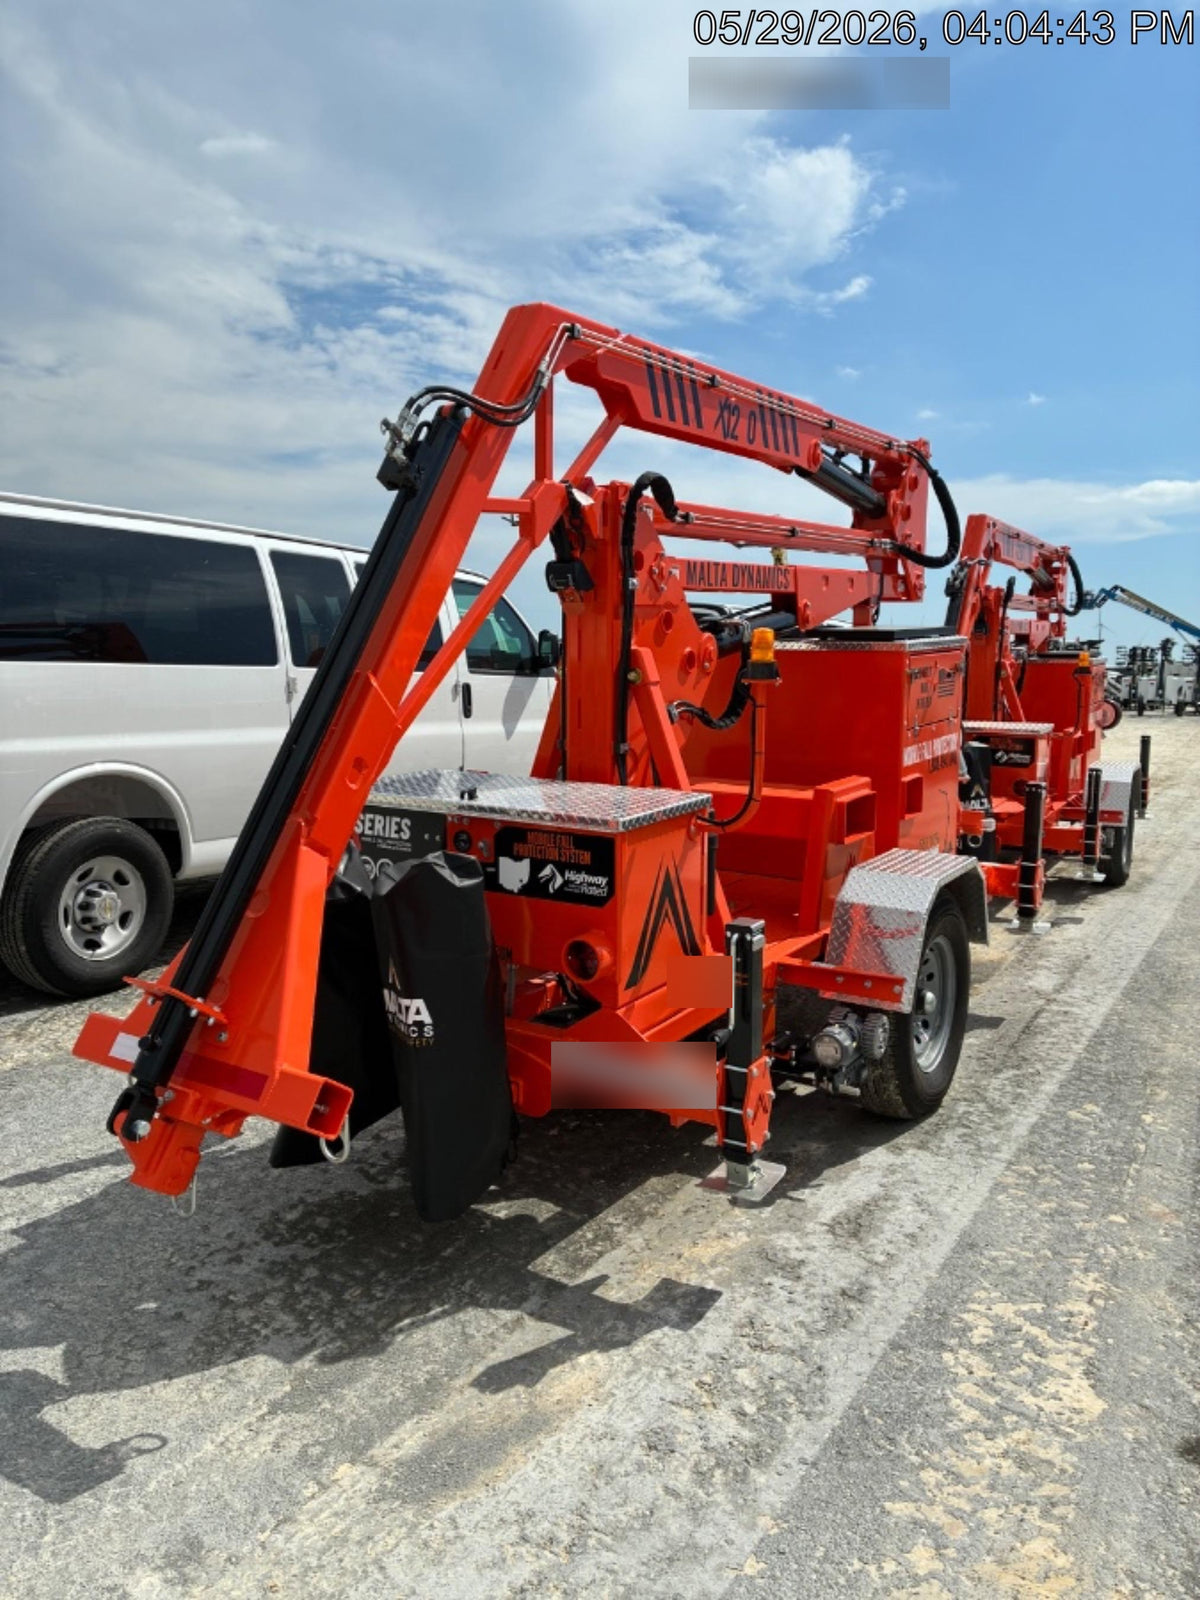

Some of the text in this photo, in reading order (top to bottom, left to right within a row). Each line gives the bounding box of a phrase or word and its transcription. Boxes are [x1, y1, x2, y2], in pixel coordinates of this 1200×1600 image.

[686, 560, 790, 589] MALTA DYNAMICS
[354, 813, 411, 840] SERIES
[556, 834, 574, 849] FALL
[513, 842, 591, 865] PROTECTION SYSTEM
[565, 869, 609, 887] Highway
[581, 884, 608, 897] Rated
